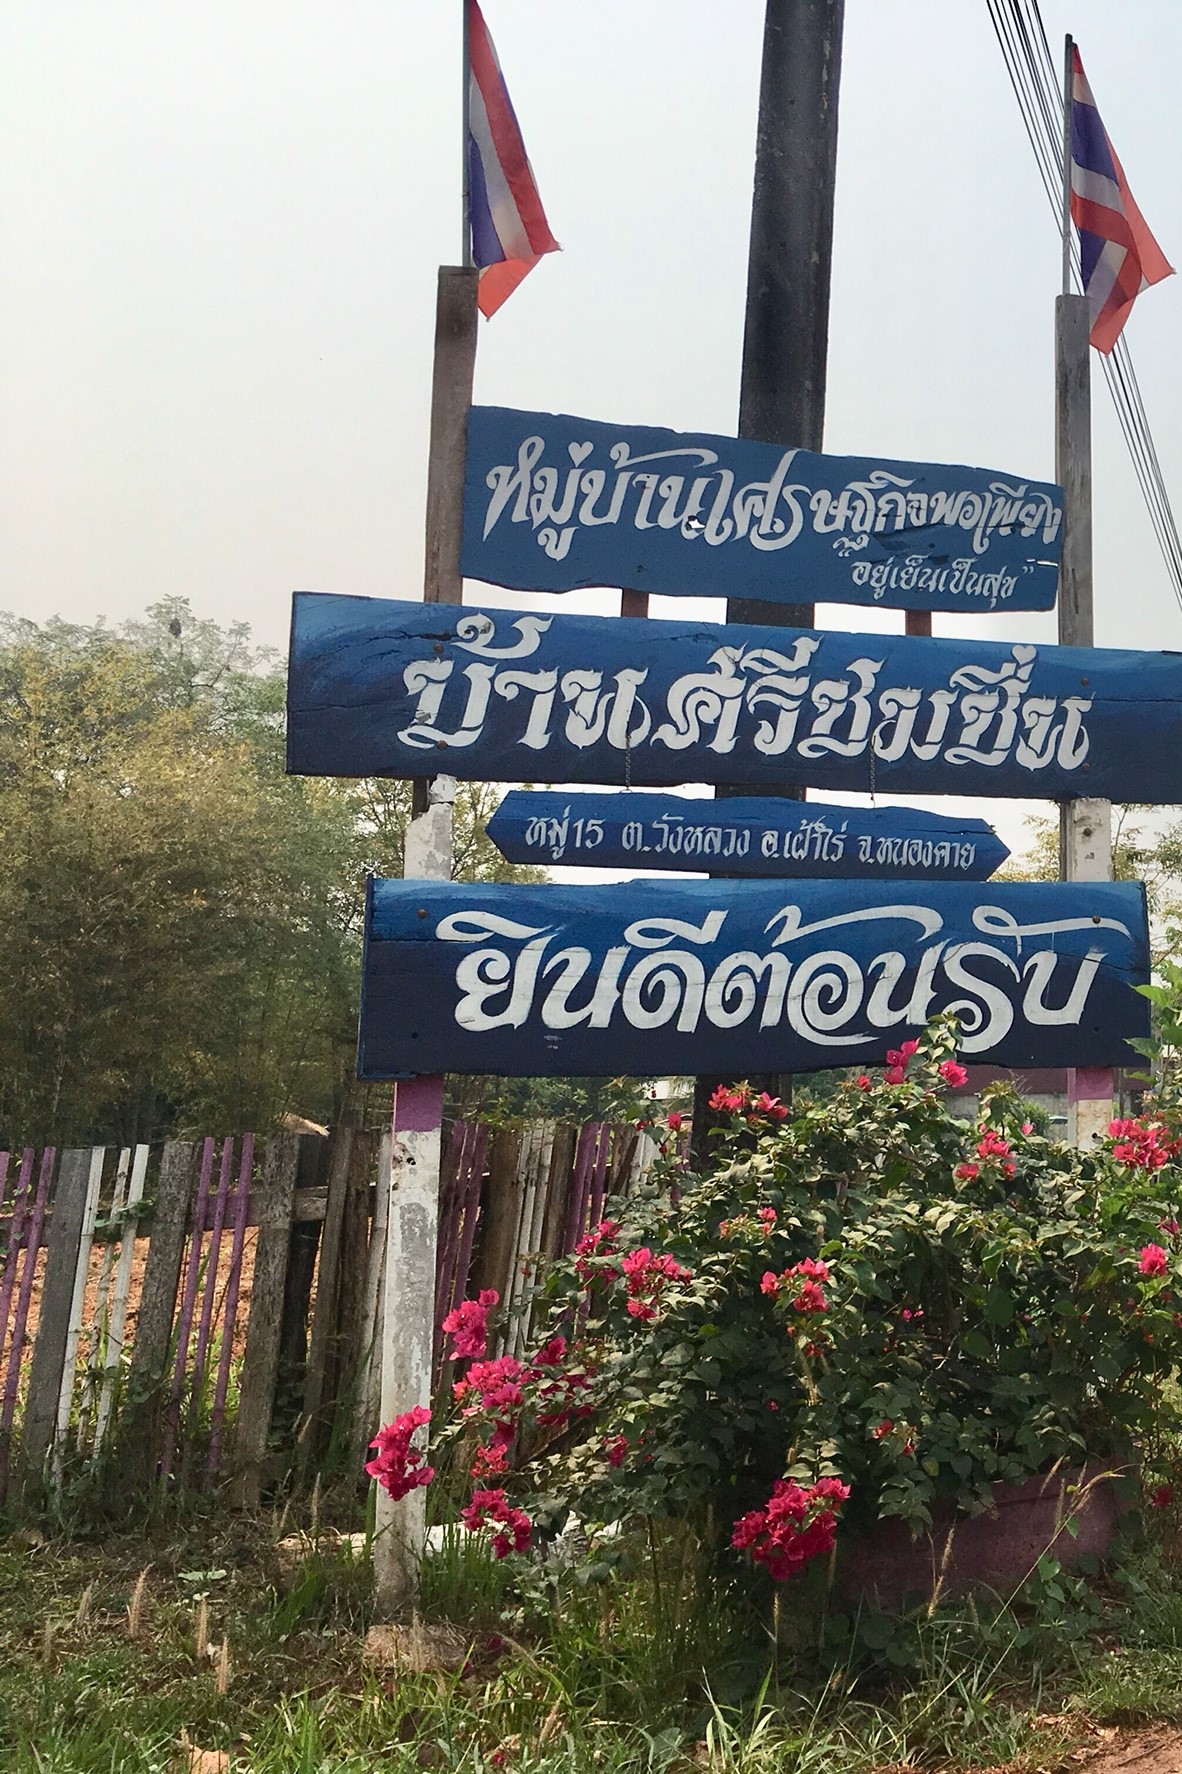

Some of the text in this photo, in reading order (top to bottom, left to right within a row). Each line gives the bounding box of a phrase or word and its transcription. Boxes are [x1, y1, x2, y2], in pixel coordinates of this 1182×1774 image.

[622, 812, 750, 857] ต.วังหลวง
[857, 835, 977, 871] จ.หนองคาย
[436, 904, 1132, 1054] ยินดีต้อนรับ
